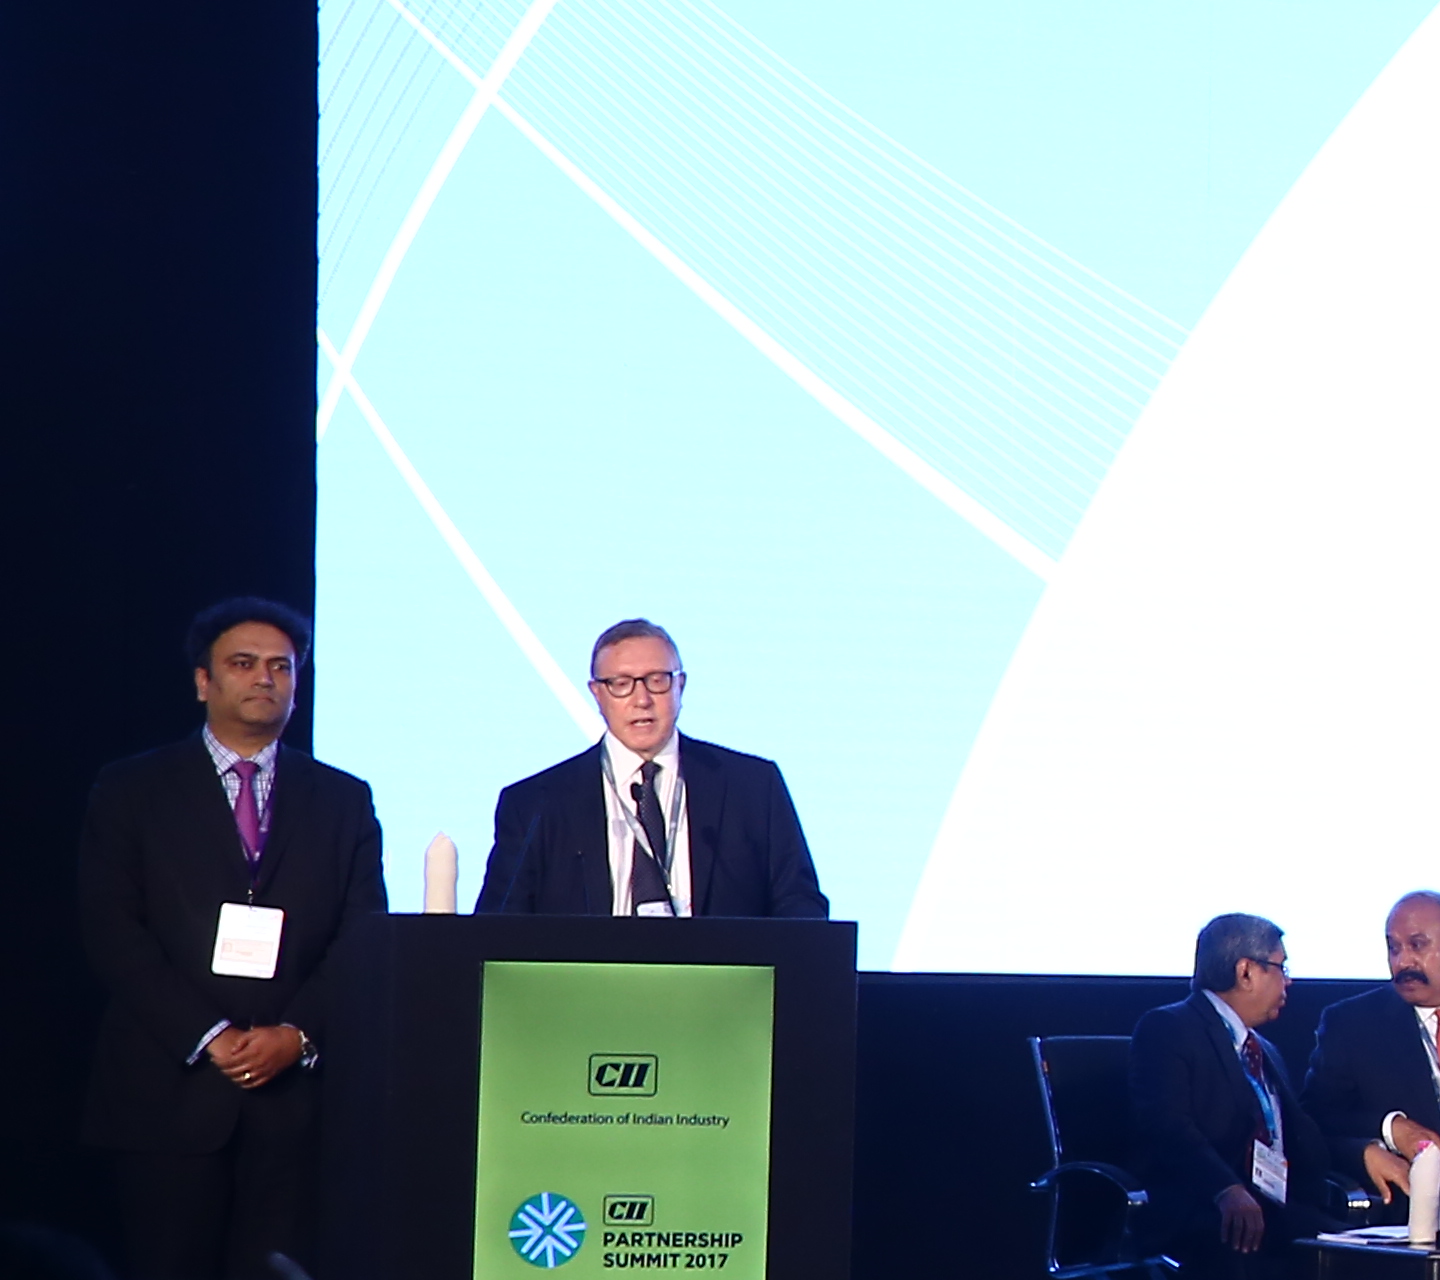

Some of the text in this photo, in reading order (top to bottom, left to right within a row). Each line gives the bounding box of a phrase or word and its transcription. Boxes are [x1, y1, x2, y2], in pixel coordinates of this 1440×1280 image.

[595, 1062, 651, 1088] CII
[520, 1111, 729, 1129] Confederation of Indian Industry
[608, 1201, 649, 1220] CII
[603, 1232, 743, 1248] PARTNERSHIP
[603, 1252, 729, 1269] SUMMIT 2017
